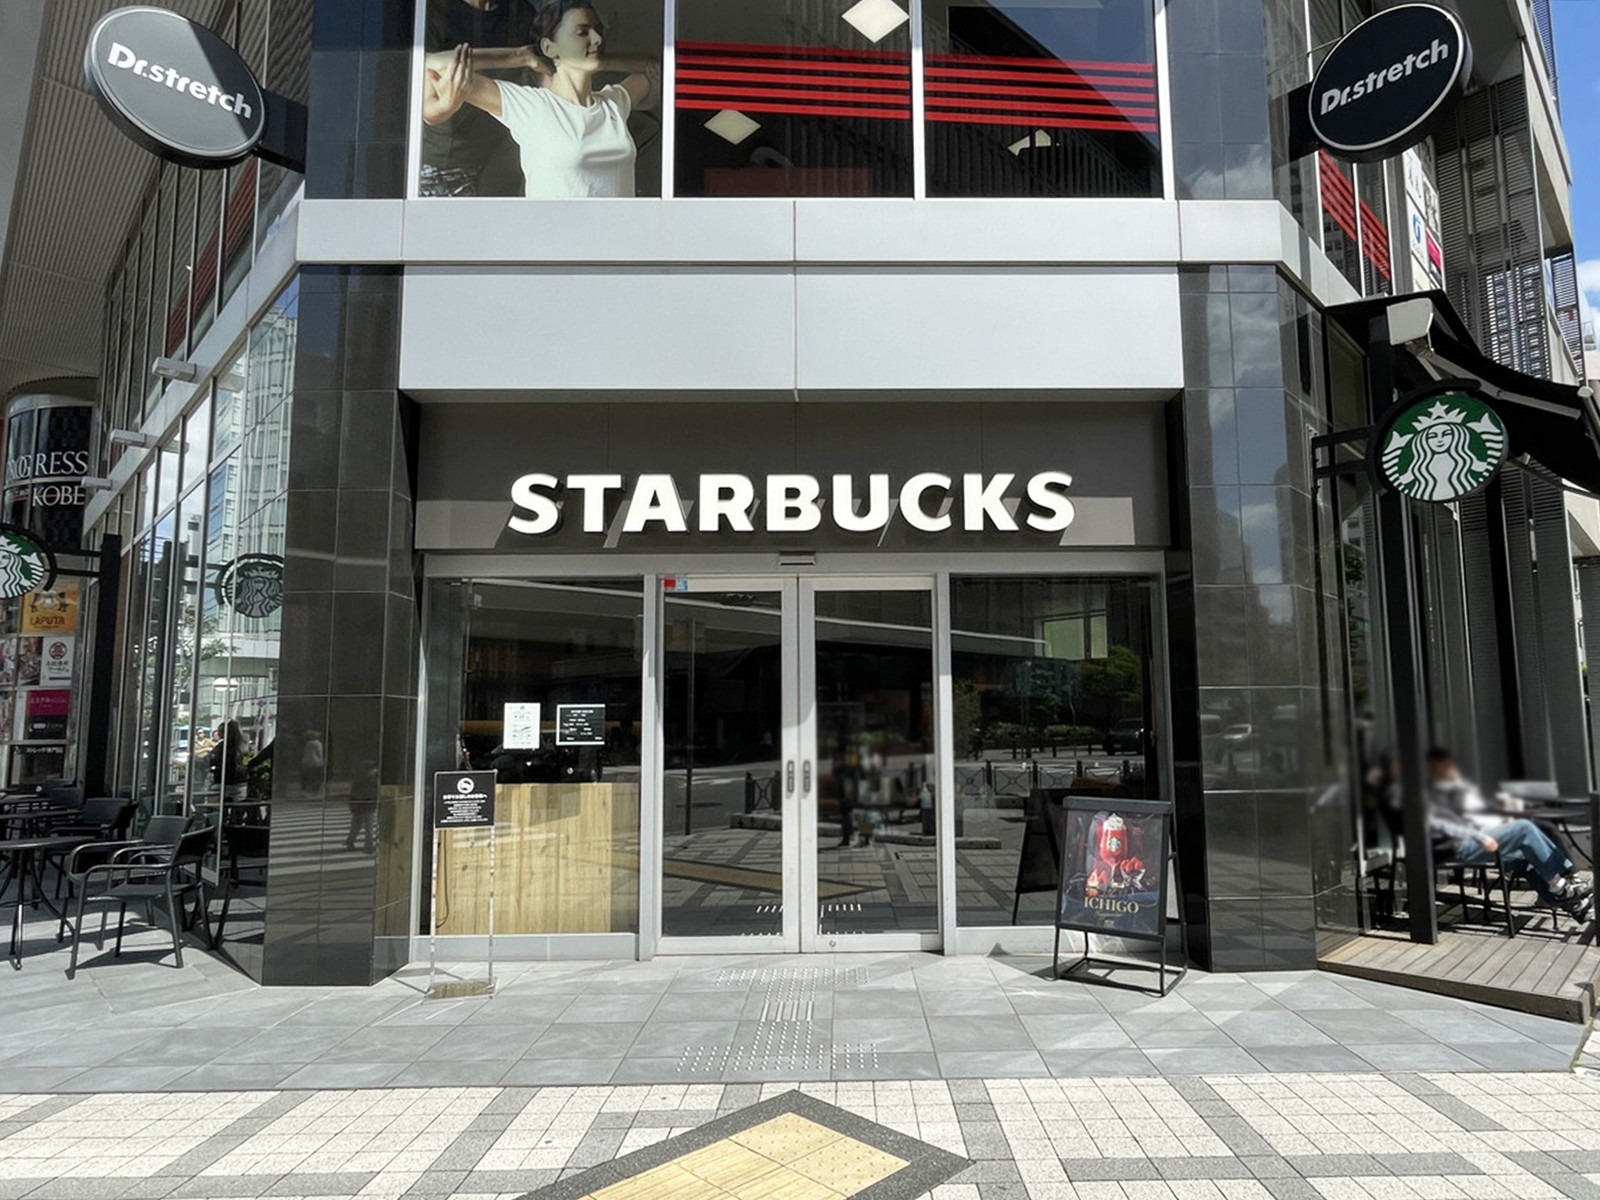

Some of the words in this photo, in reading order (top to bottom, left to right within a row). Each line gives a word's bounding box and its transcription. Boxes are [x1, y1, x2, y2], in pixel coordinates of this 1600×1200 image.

[107, 42, 252, 119] Dr.stretch
[1320, 39, 1449, 116] Dr.stretch
[32, 485, 85, 506] KOBE
[507, 471, 1076, 535] STARBUCKS
[1084, 896, 1139, 913] ICHIGO
